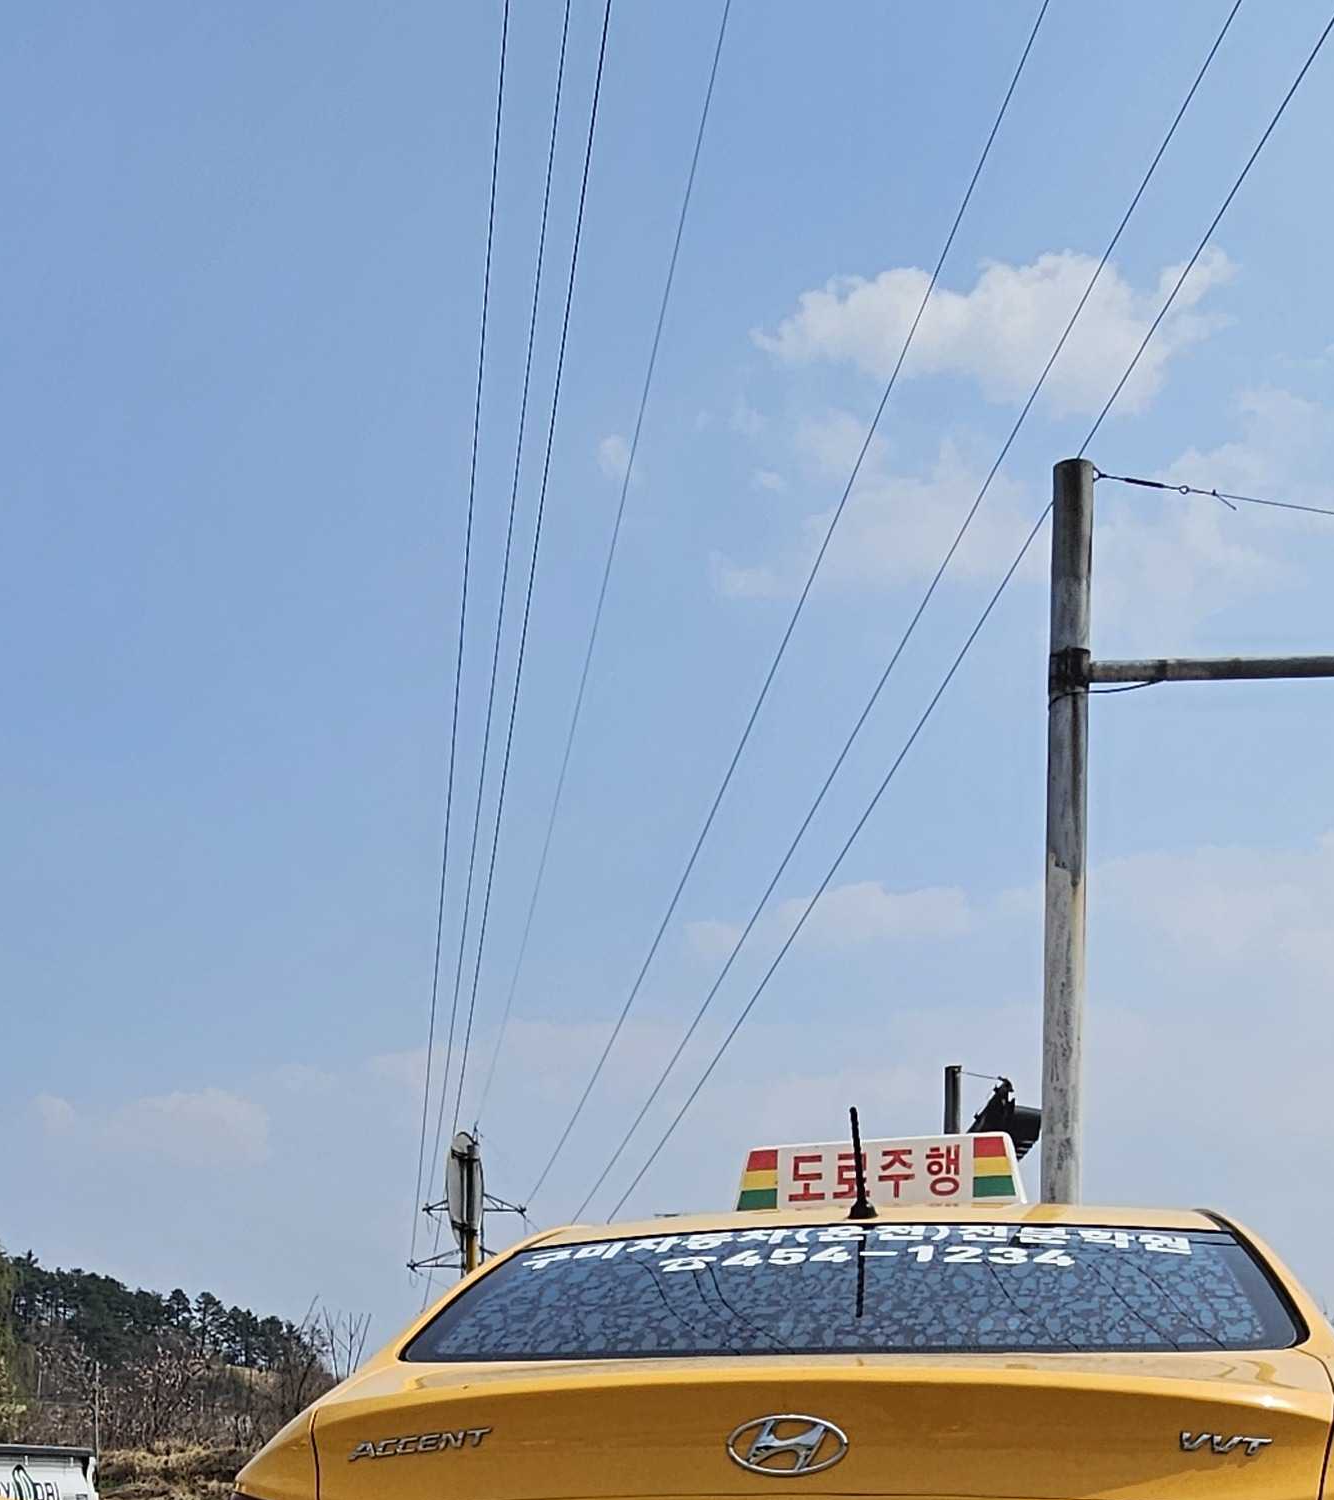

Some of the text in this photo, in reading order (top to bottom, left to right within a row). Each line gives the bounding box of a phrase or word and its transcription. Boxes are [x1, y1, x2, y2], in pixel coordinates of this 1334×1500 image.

[788, 1144, 961, 1202] 도로주행
[721, 1245, 1075, 1266] 454-1234
[348, 1426, 493, 1462] ACCENT
[1180, 1431, 1273, 1456] VVT
